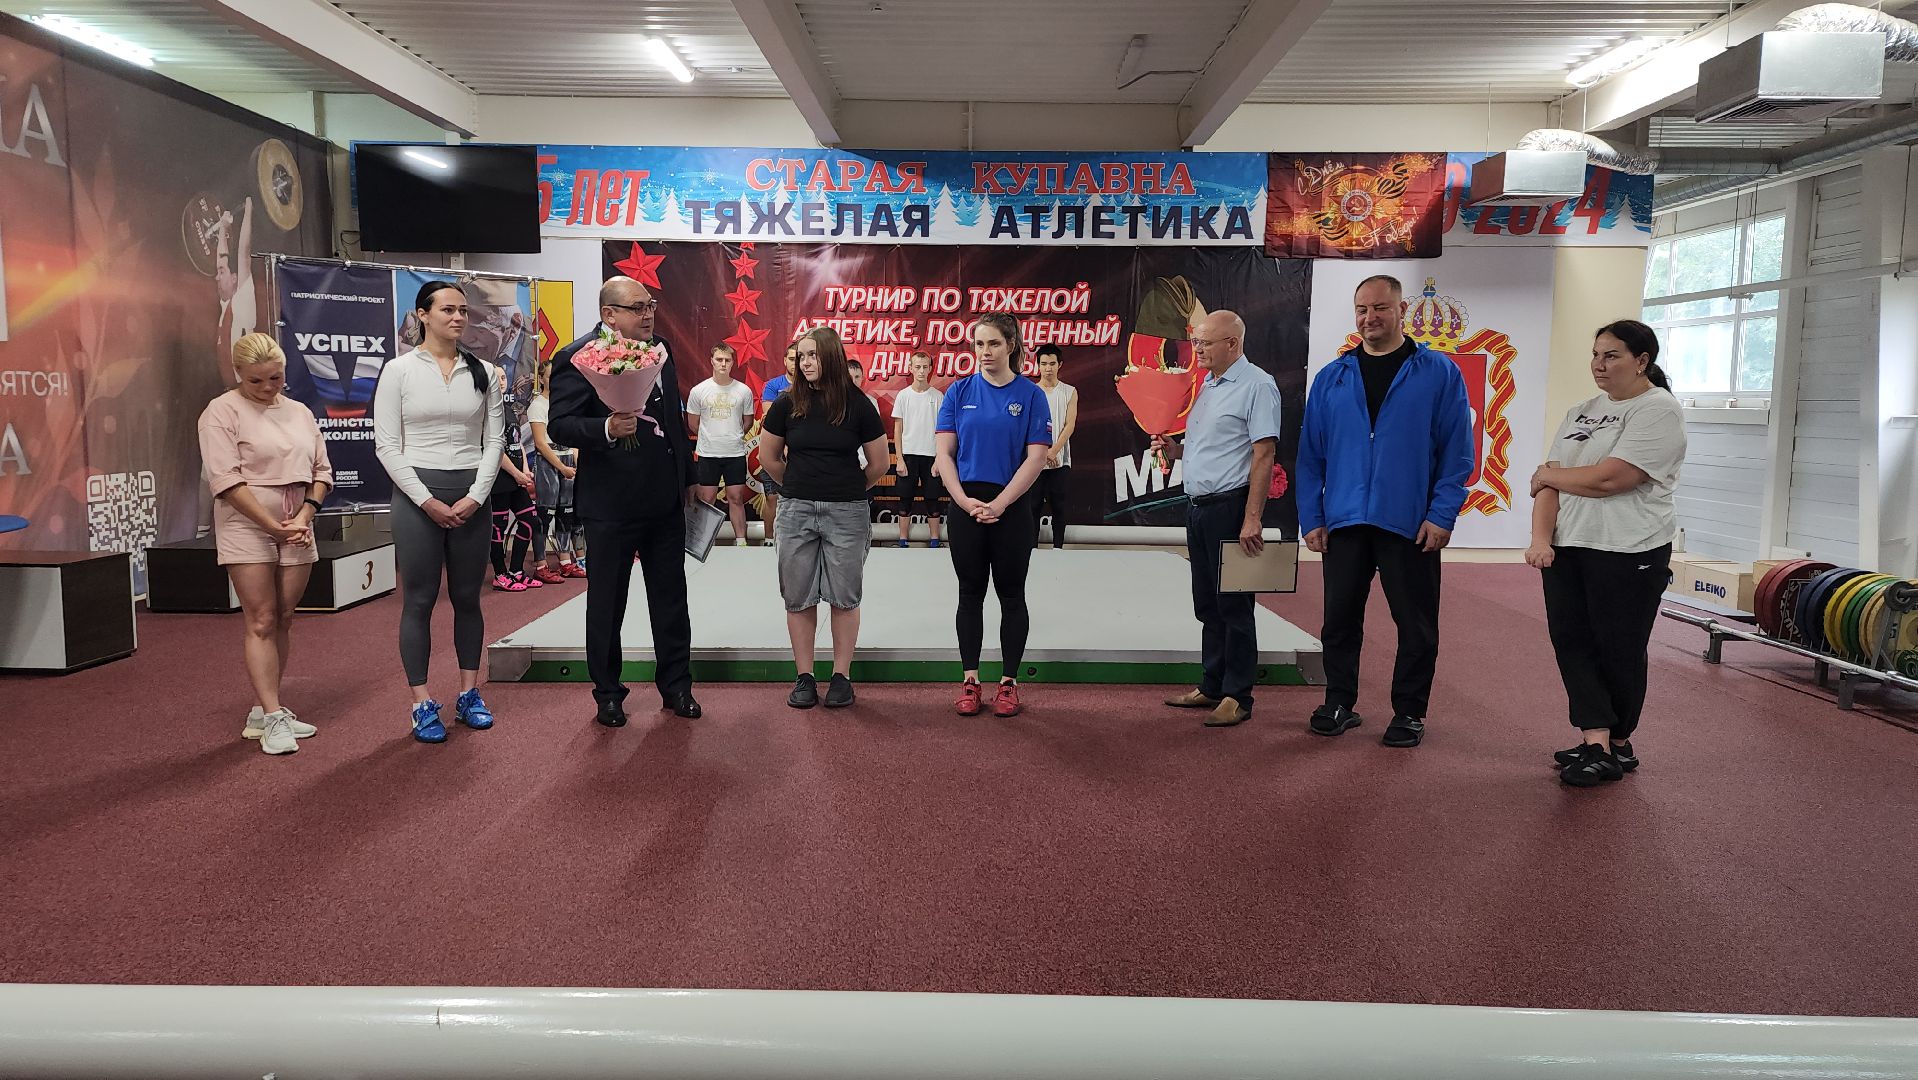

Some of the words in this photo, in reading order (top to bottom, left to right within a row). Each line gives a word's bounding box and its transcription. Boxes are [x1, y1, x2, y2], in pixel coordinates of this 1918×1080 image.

[746, 158, 928, 194] СТАРАЯ
[971, 162, 1197, 196] КУПАВНА
[685, 200, 930, 238] ТЯЖЕЛАЯ
[989, 205, 1254, 240] АТЛЕТИКА
[825, 287, 916, 310] ТУРНИР
[922, 288, 961, 312] ПО
[969, 283, 1090, 312] ТЯЖЕЛОЙ
[295, 332, 386, 354] УСПЕХ
[361, 560, 374, 591] 3
[1695, 579, 1727, 599] ELEIKO
